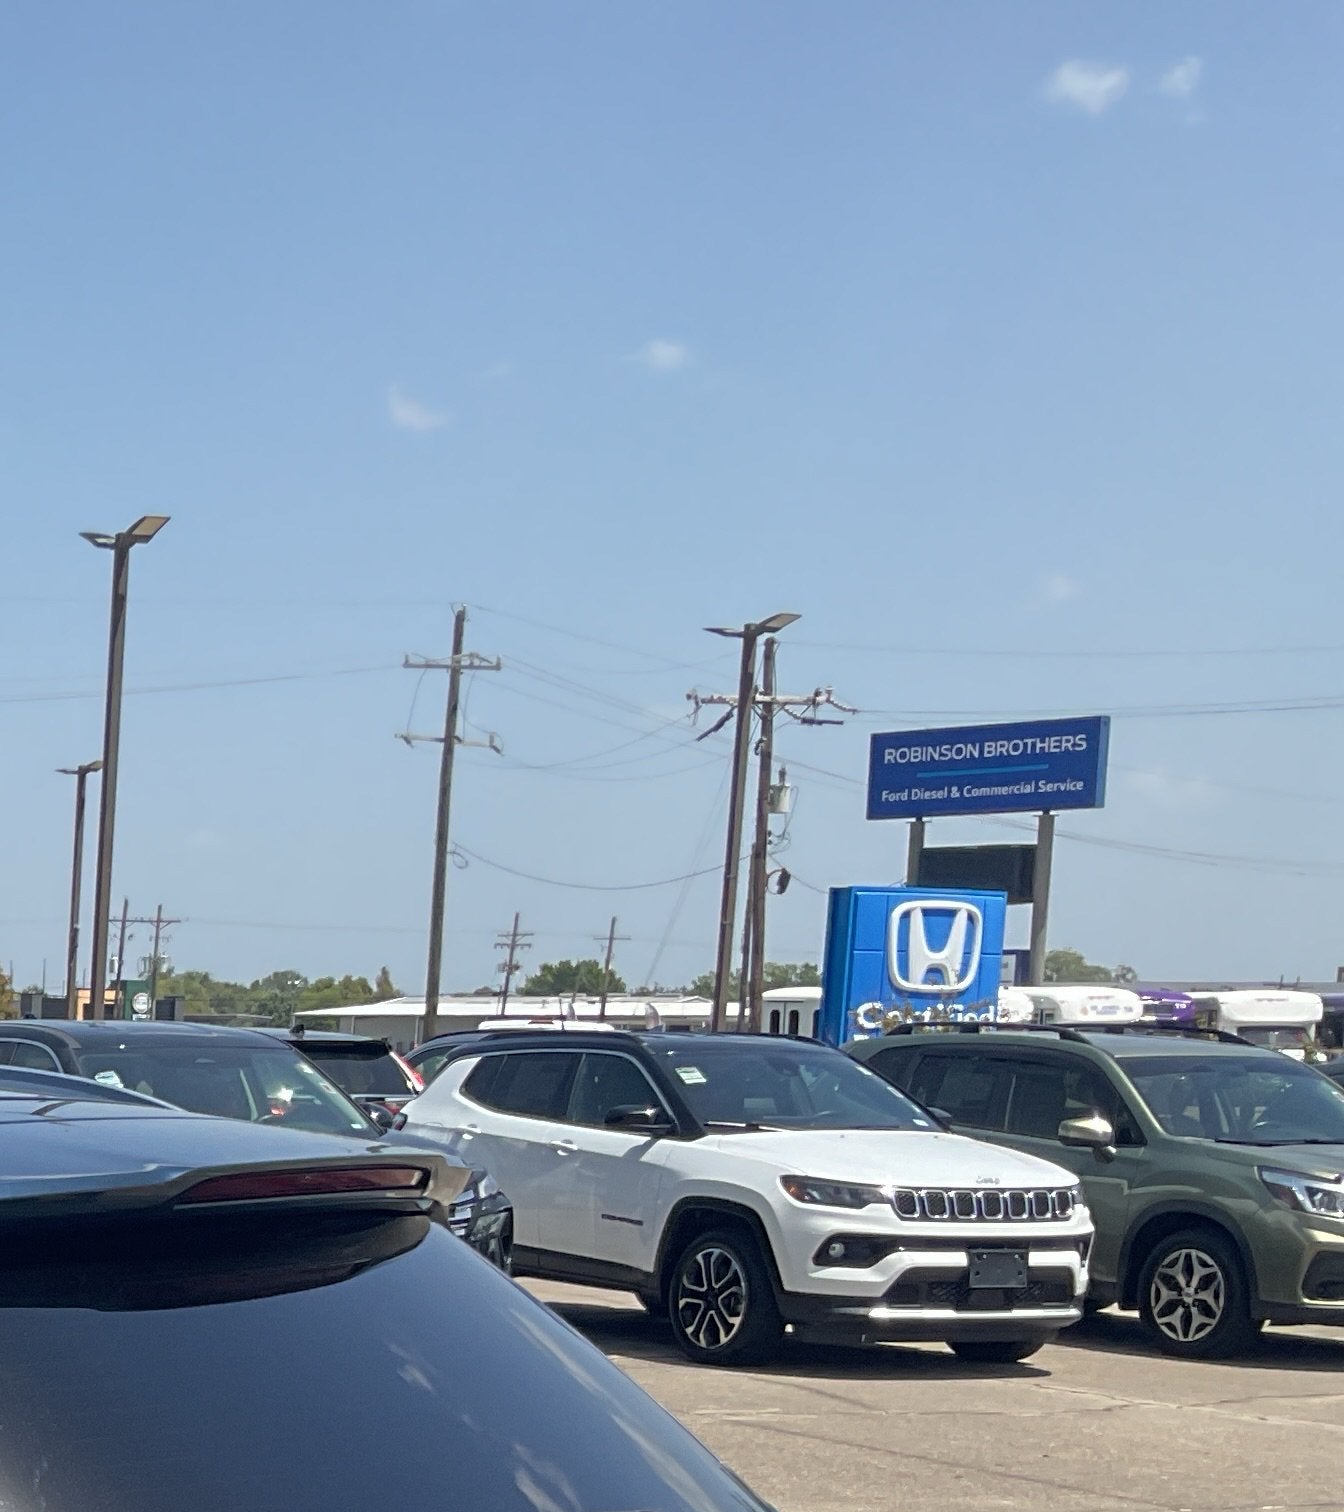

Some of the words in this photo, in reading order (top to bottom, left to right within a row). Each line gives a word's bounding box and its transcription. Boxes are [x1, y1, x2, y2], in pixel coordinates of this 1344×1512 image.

[883, 743, 980, 764] ROBINSON
[983, 734, 1088, 758] BROTHERS
[881, 788, 908, 802] Ford
[911, 785, 948, 801] Diesel
[950, 785, 961, 798] &
[963, 779, 1035, 798] Commercial
[1037, 778, 1084, 793] Service
[856, 1001, 995, 1029] Cefied
